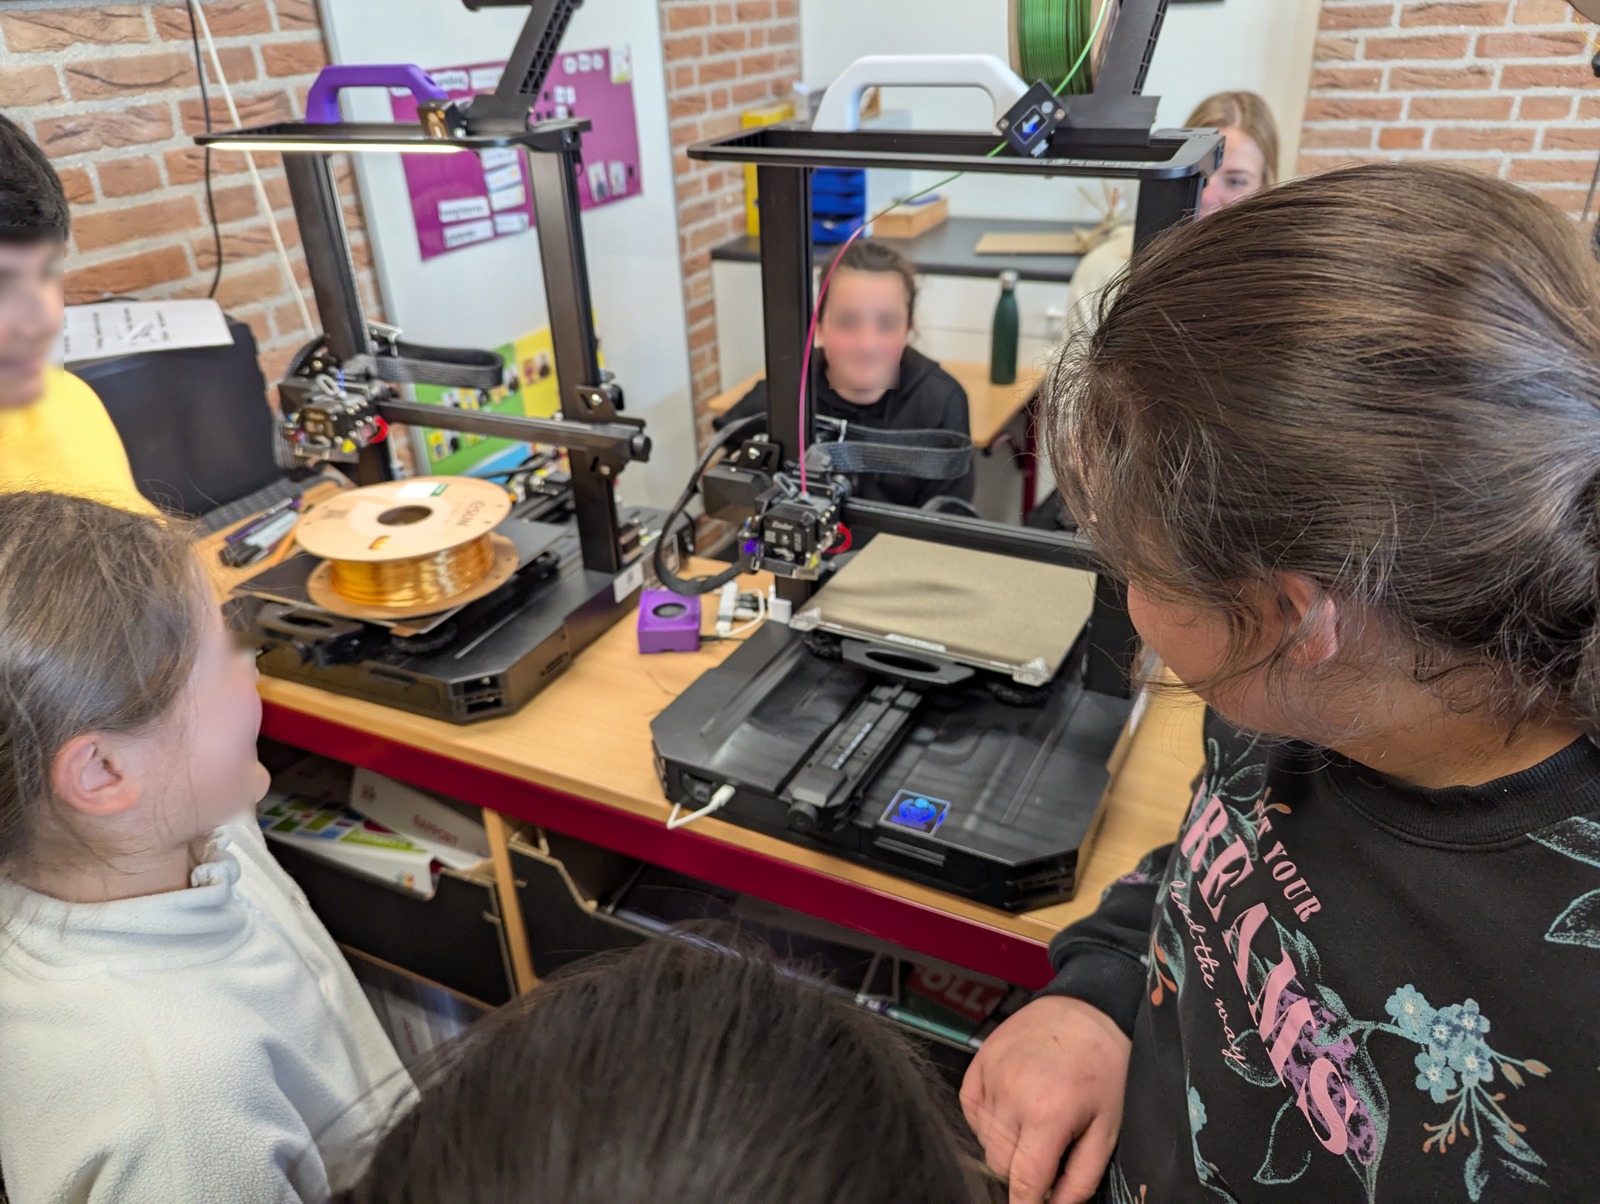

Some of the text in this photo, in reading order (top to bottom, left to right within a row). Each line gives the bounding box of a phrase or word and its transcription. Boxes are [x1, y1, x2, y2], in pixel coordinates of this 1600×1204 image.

[1263, 841, 1321, 922] YOUR
[1169, 880, 1246, 1069] lead the way
